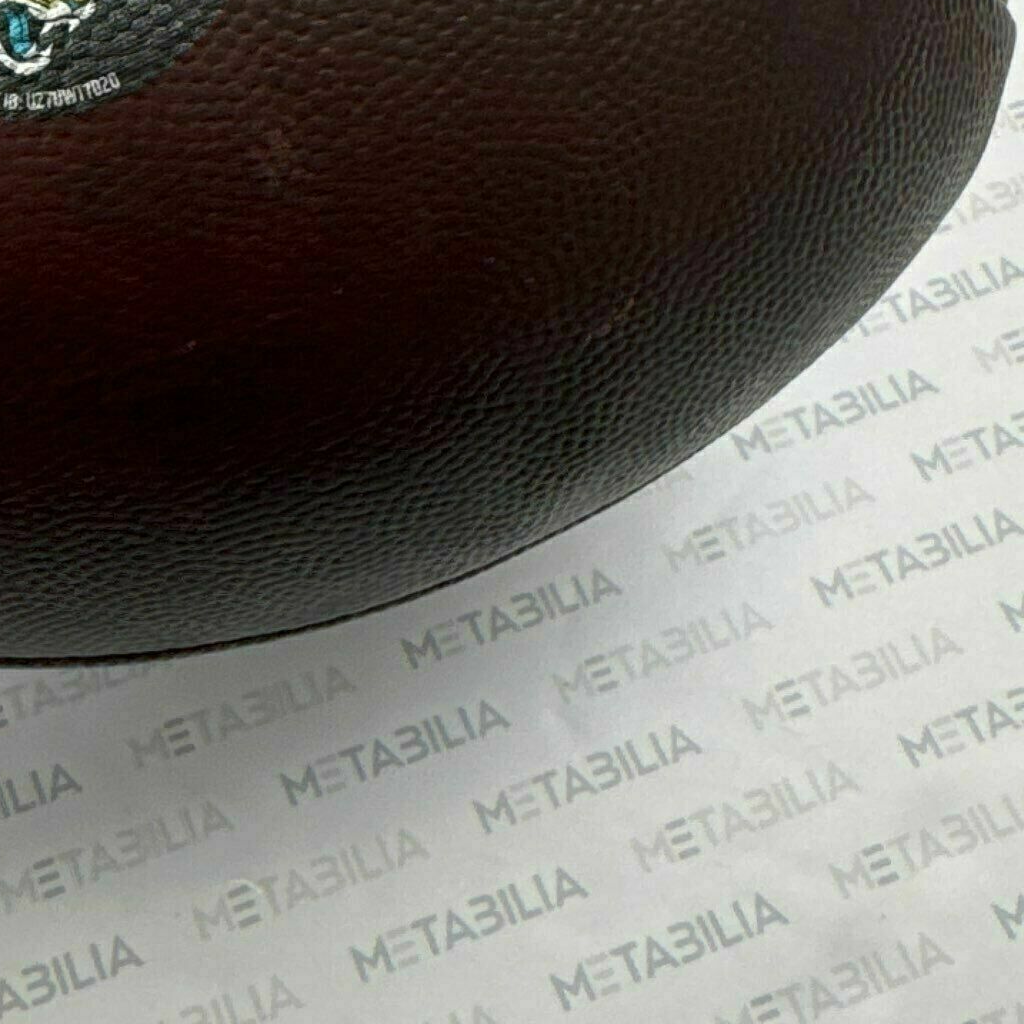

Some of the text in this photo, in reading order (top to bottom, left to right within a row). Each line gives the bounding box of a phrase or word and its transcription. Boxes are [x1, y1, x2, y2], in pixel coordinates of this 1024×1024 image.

[731, 370, 940, 460] METABILIA
[400, 568, 623, 670] METABILIA
[280, 700, 510, 806] METABILIA
[471, 725, 703, 835] METABILIA
[349, 867, 589, 983] METABILIA
[550, 892, 790, 1012] METABILIA
